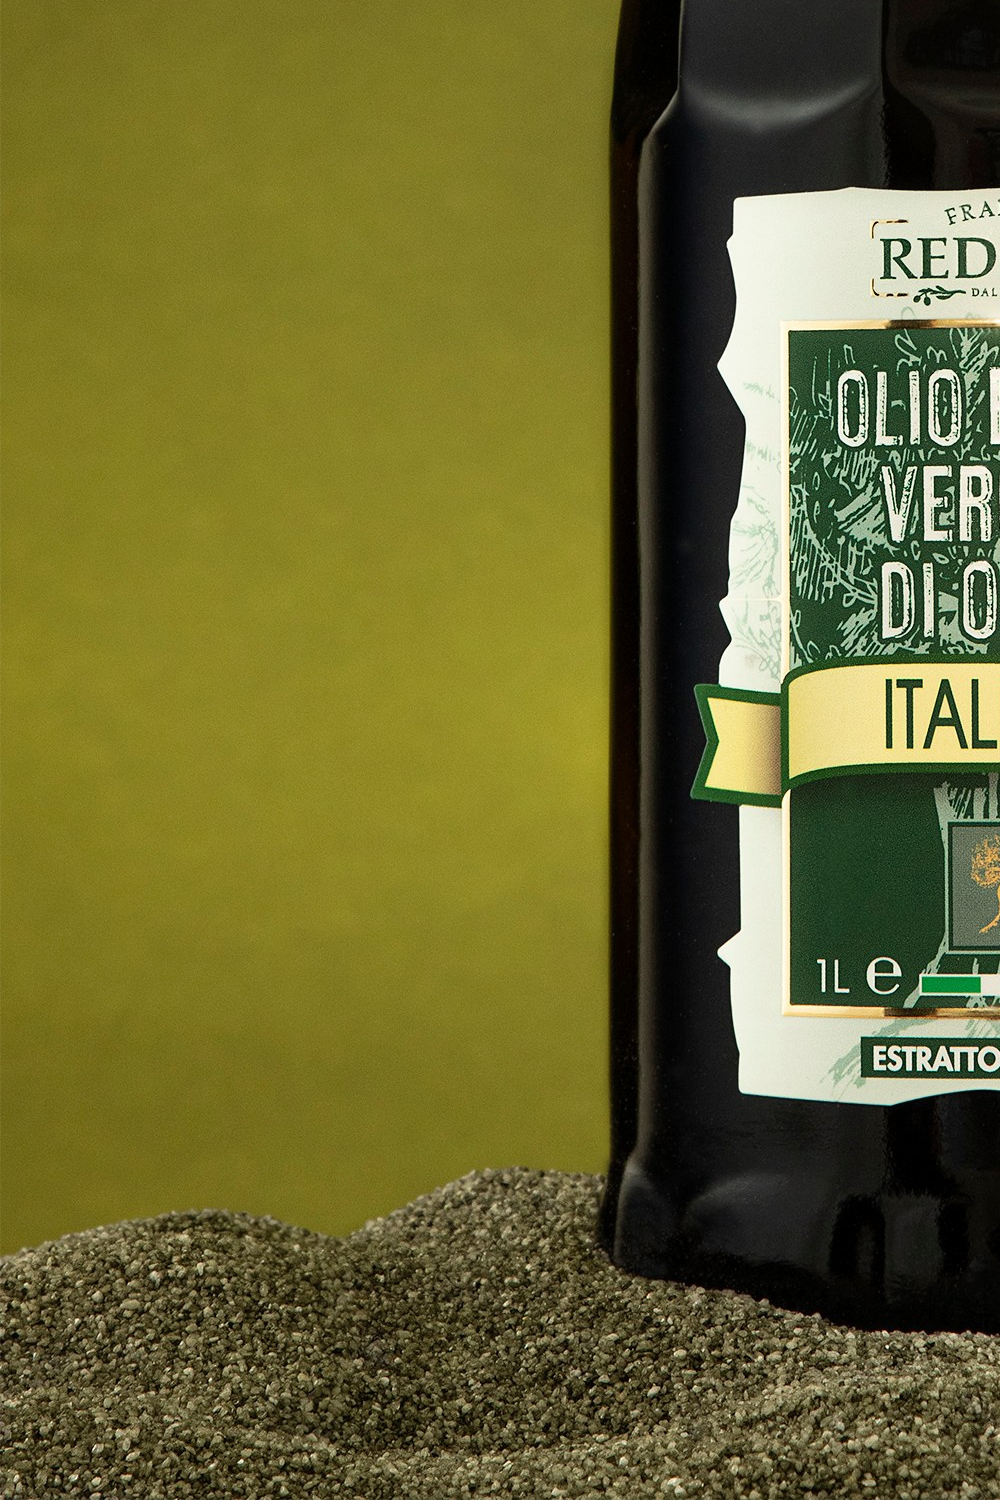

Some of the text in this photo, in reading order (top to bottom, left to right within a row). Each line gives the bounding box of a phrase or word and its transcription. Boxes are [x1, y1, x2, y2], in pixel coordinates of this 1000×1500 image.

[971, 288, 997, 297] DAL
[837, 369, 960, 447] OLIO
[881, 562, 935, 639] DI
[816, 959, 849, 994] 1L
